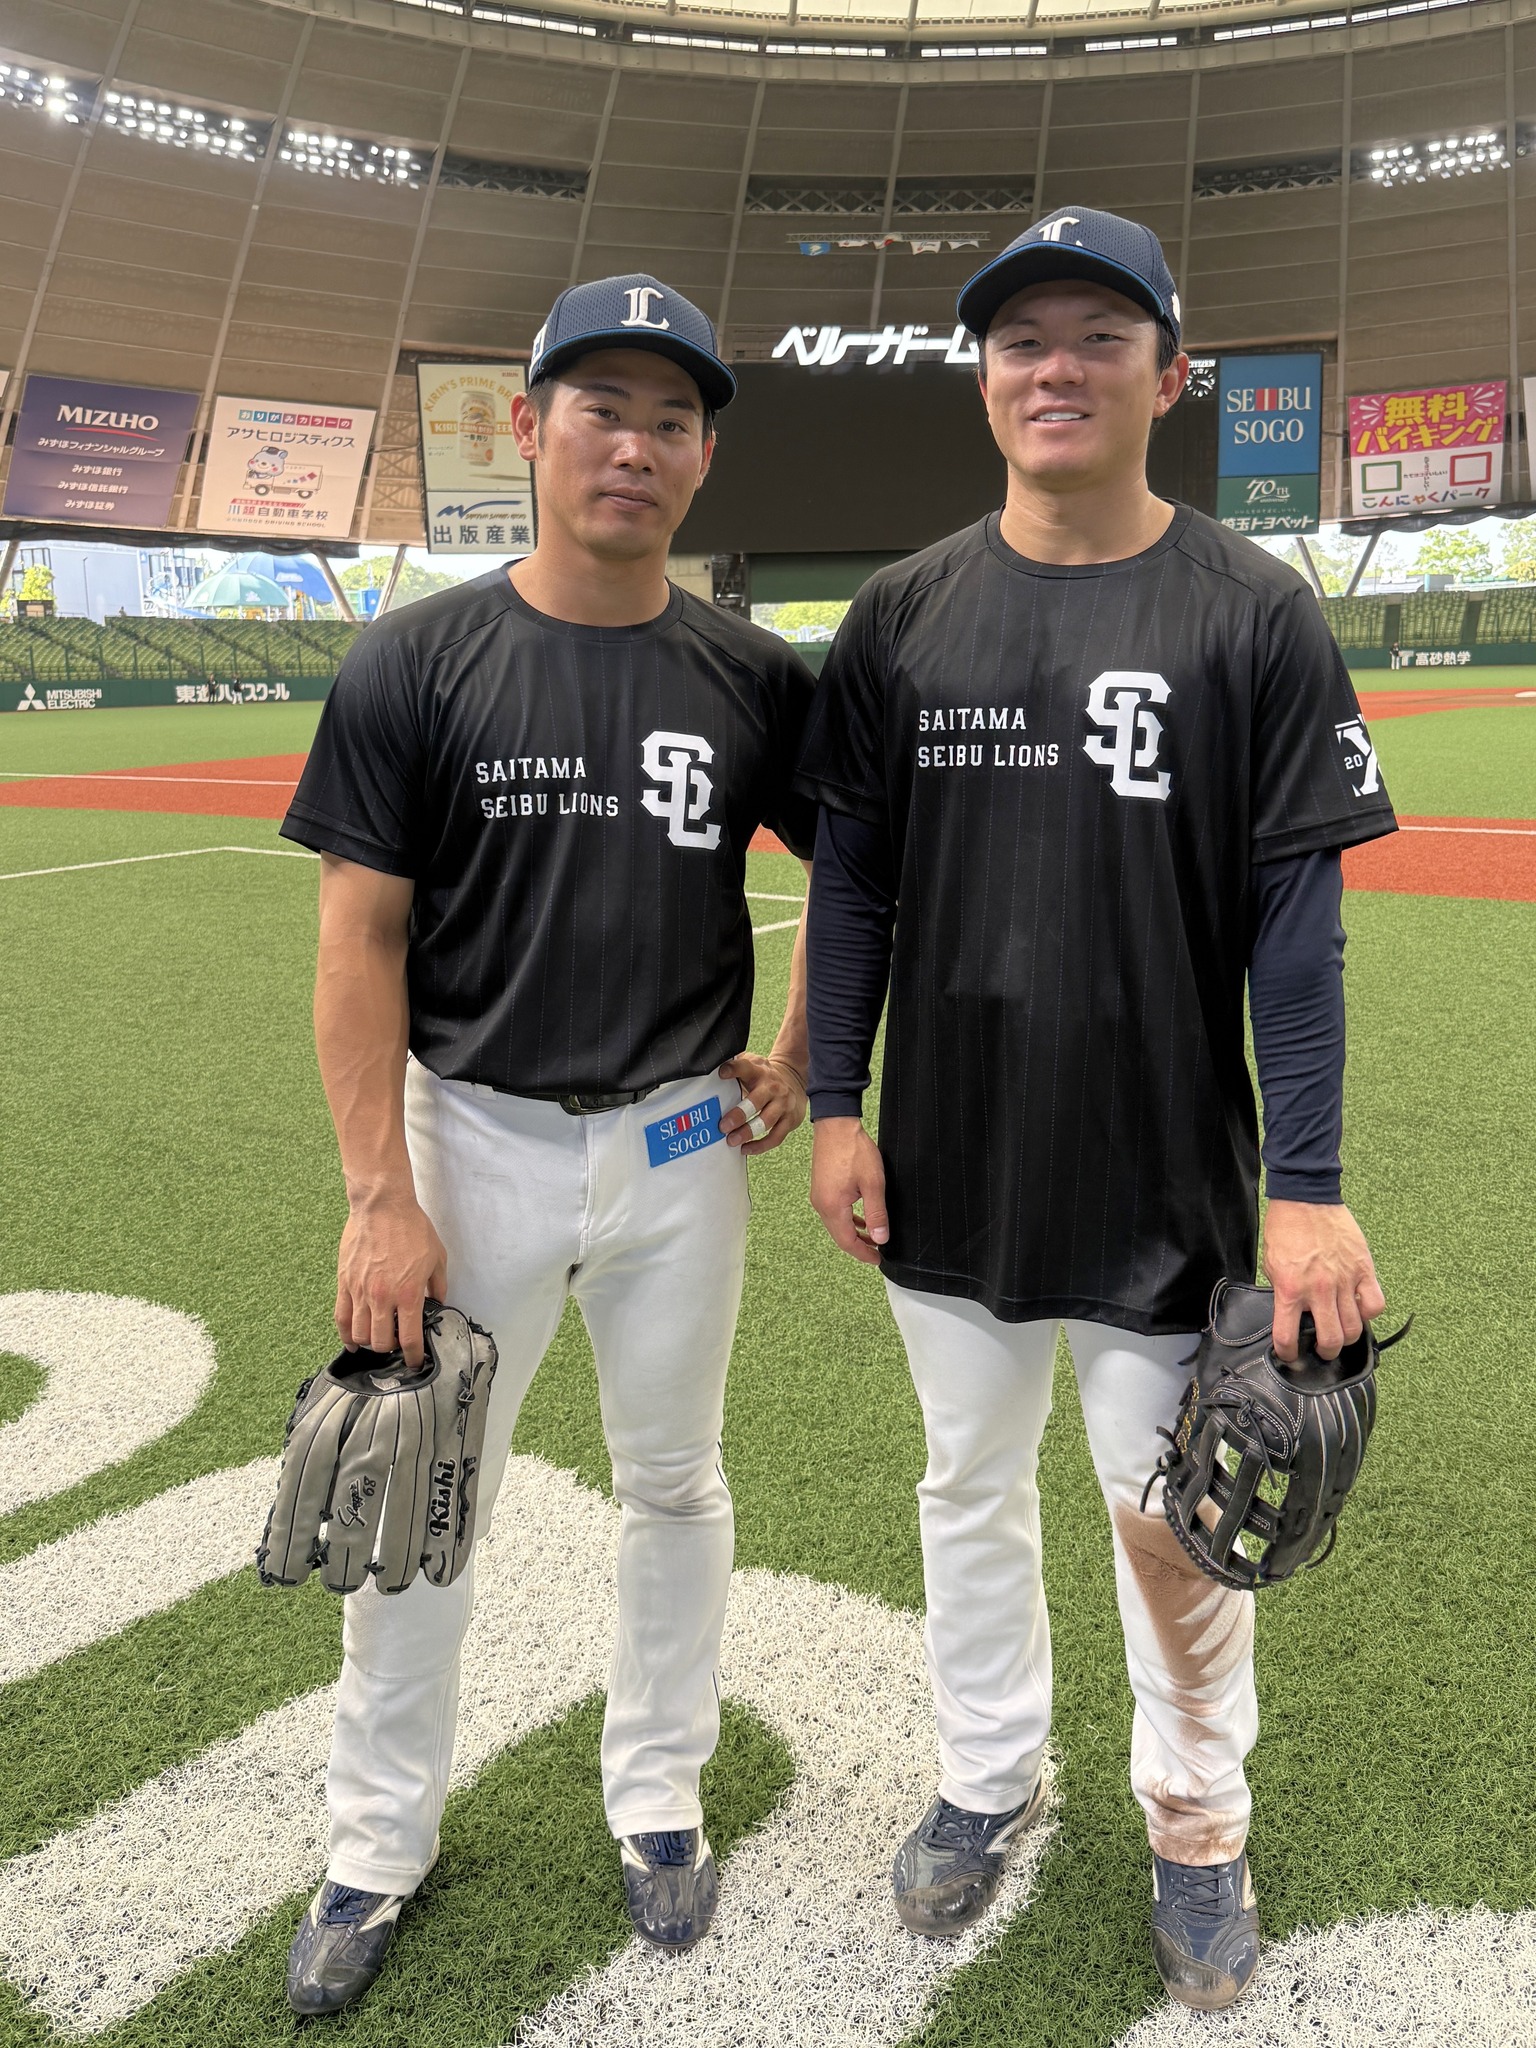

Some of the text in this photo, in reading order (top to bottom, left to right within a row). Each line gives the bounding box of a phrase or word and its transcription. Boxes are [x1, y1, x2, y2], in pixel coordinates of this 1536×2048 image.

[771, 325, 980, 366] ベルーナドーム
[423, 378, 458, 413] KIRIN'S
[459, 376, 497, 391] PRIME
[1226, 387, 1312, 413] SEIBU
[56, 404, 159, 431] MIZUHO
[239, 410, 352, 429] おりがみカラーの
[1384, 391, 1469, 427] 無料
[227, 427, 356, 448] アサヒロジスティクス
[1233, 418, 1304, 445] SOGO
[1356, 416, 1499, 454] バイキング
[37, 437, 165, 458] みずほフィナンシャルグループ
[72, 464, 123, 477] みずほ銀行
[58, 481, 129, 495] みずほ信託銀行
[1362, 487, 1491, 509] こんにゃくパーク
[64, 499, 115, 511] みずほ証券
[228, 505, 329, 521] 川越自動車学校
[1221, 515, 1315, 532] 埼玉トヨペット
[433, 525, 531, 545] 出版産業
[1415, 650, 1472, 666] 高砂熱学
[46, 688, 103, 700] MITSUBISHI
[47, 698, 96, 709] ELECTRIC
[176, 683, 291, 703] 東進ハスクール
[918, 707, 1027, 732] SAITAMA
[917, 743, 1060, 768] SEIBU LIONS
[1343, 753, 1363, 770] 20
[475, 756, 587, 784] SAITAMA
[480, 792, 619, 819] SEIBU LIONS
[659, 1105, 711, 1141] SEIBU
[668, 1128, 711, 1158] SOGO
[362, 1475, 377, 1497] 68
[429, 1457, 458, 1538] Kishi
